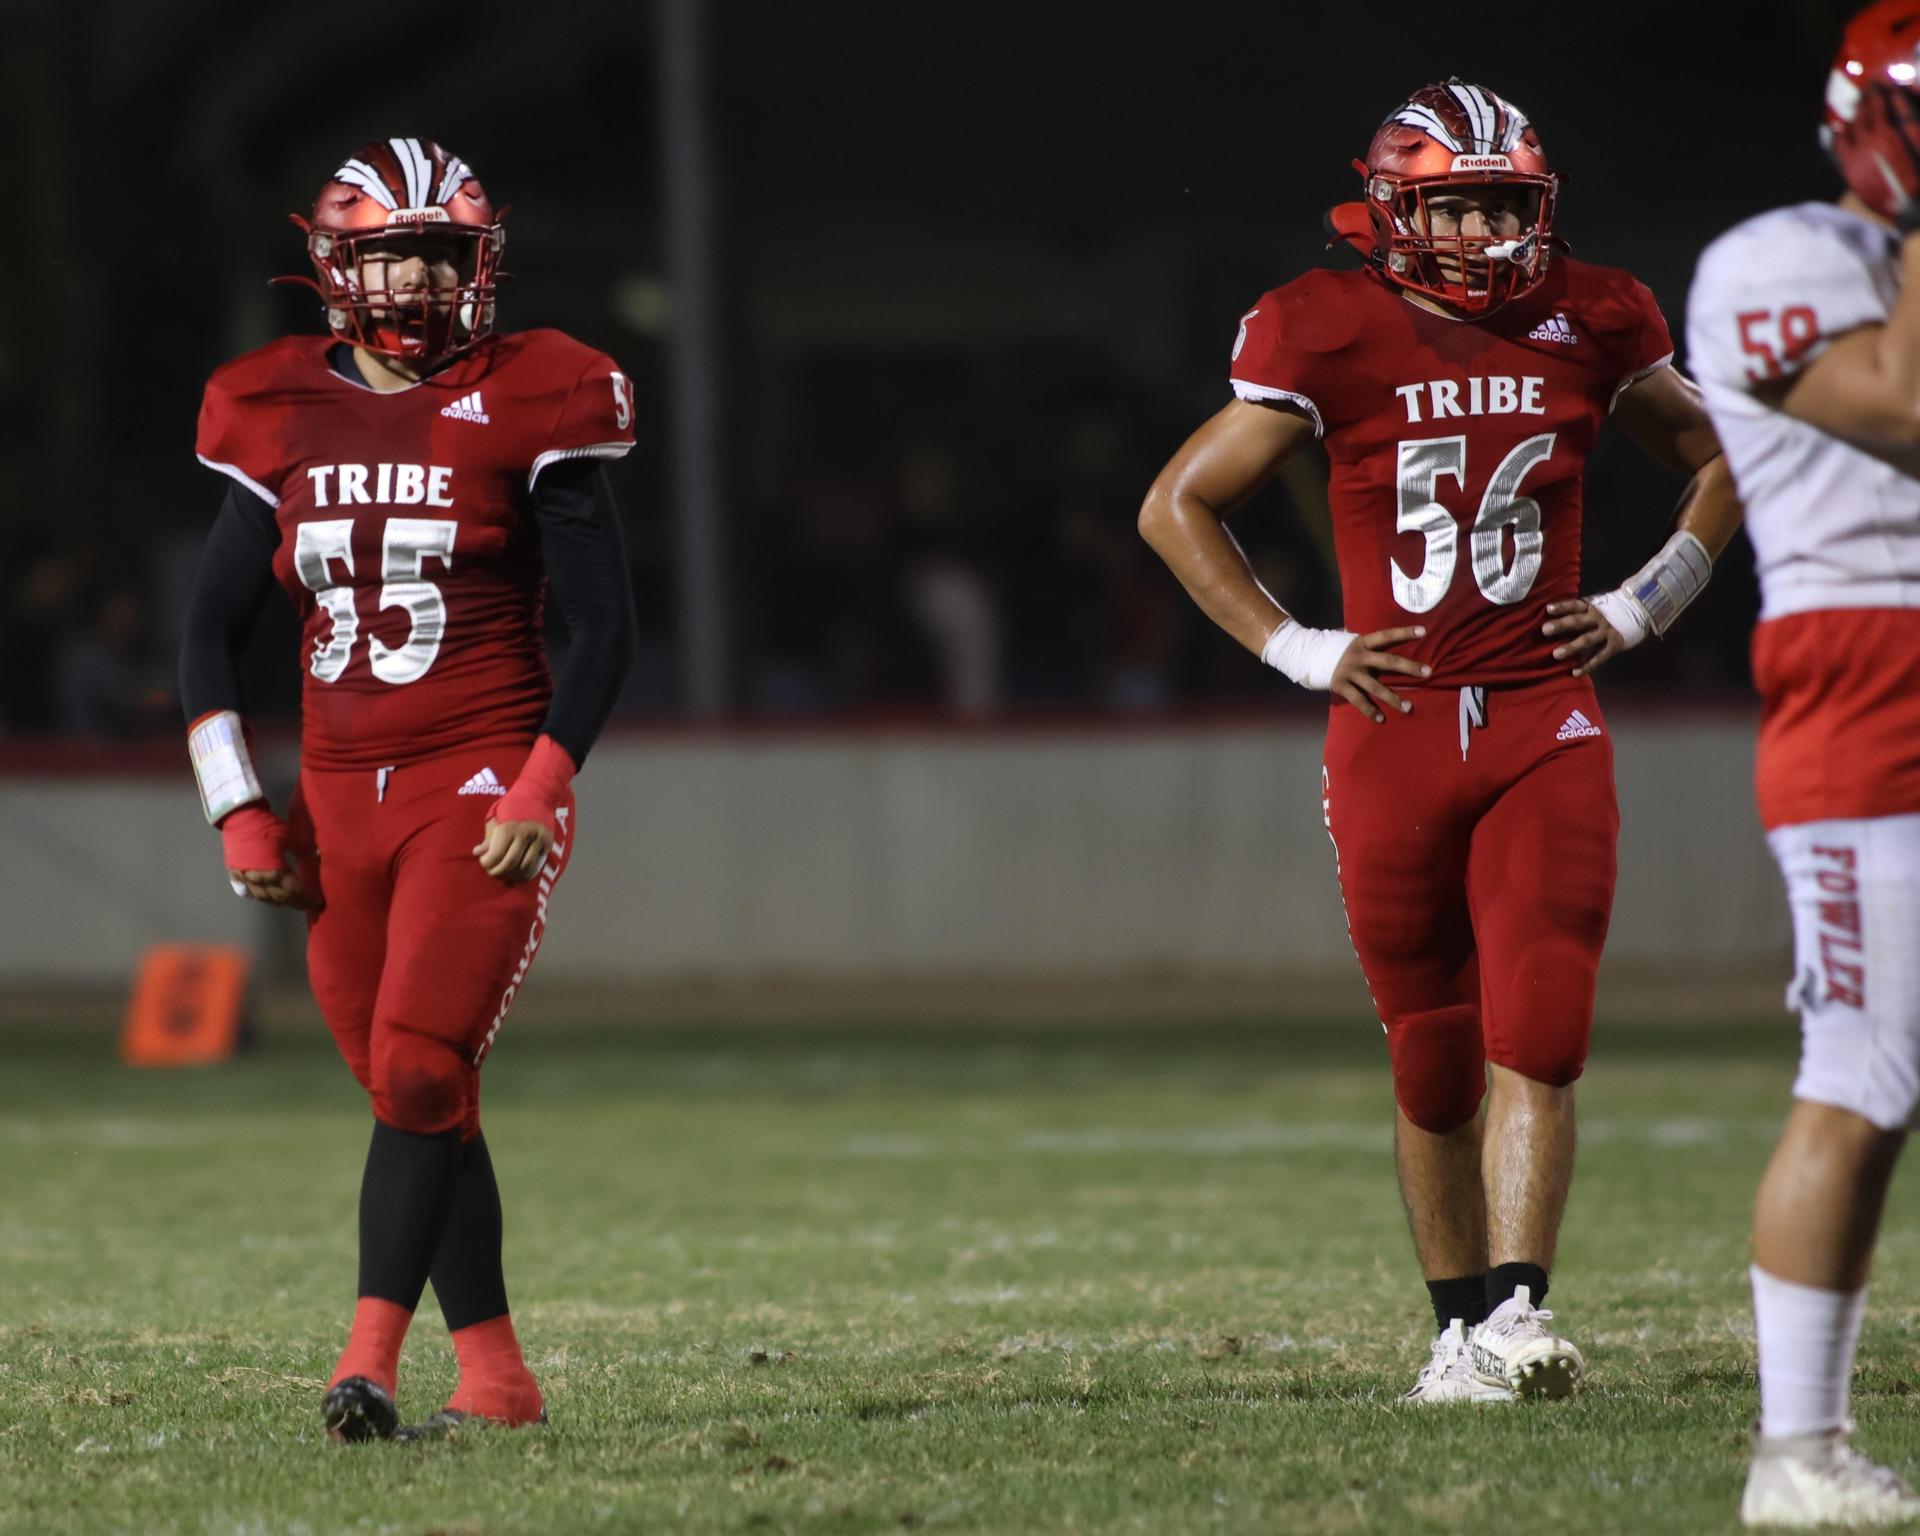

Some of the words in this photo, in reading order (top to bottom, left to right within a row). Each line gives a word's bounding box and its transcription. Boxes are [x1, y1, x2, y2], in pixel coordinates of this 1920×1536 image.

[1460, 158, 1507, 168] Riddell
[1528, 330, 1578, 345] adidas
[440, 406, 490, 425] adidas
[1396, 376, 1546, 423] TRIBE
[307, 463, 454, 508] TRIBE
[1390, 433, 1557, 614] 56
[294, 518, 458, 685] 55
[1556, 725, 1602, 741] adidas
[457, 784, 506, 796] adidas
[1812, 845, 1866, 1010] FOWLER
